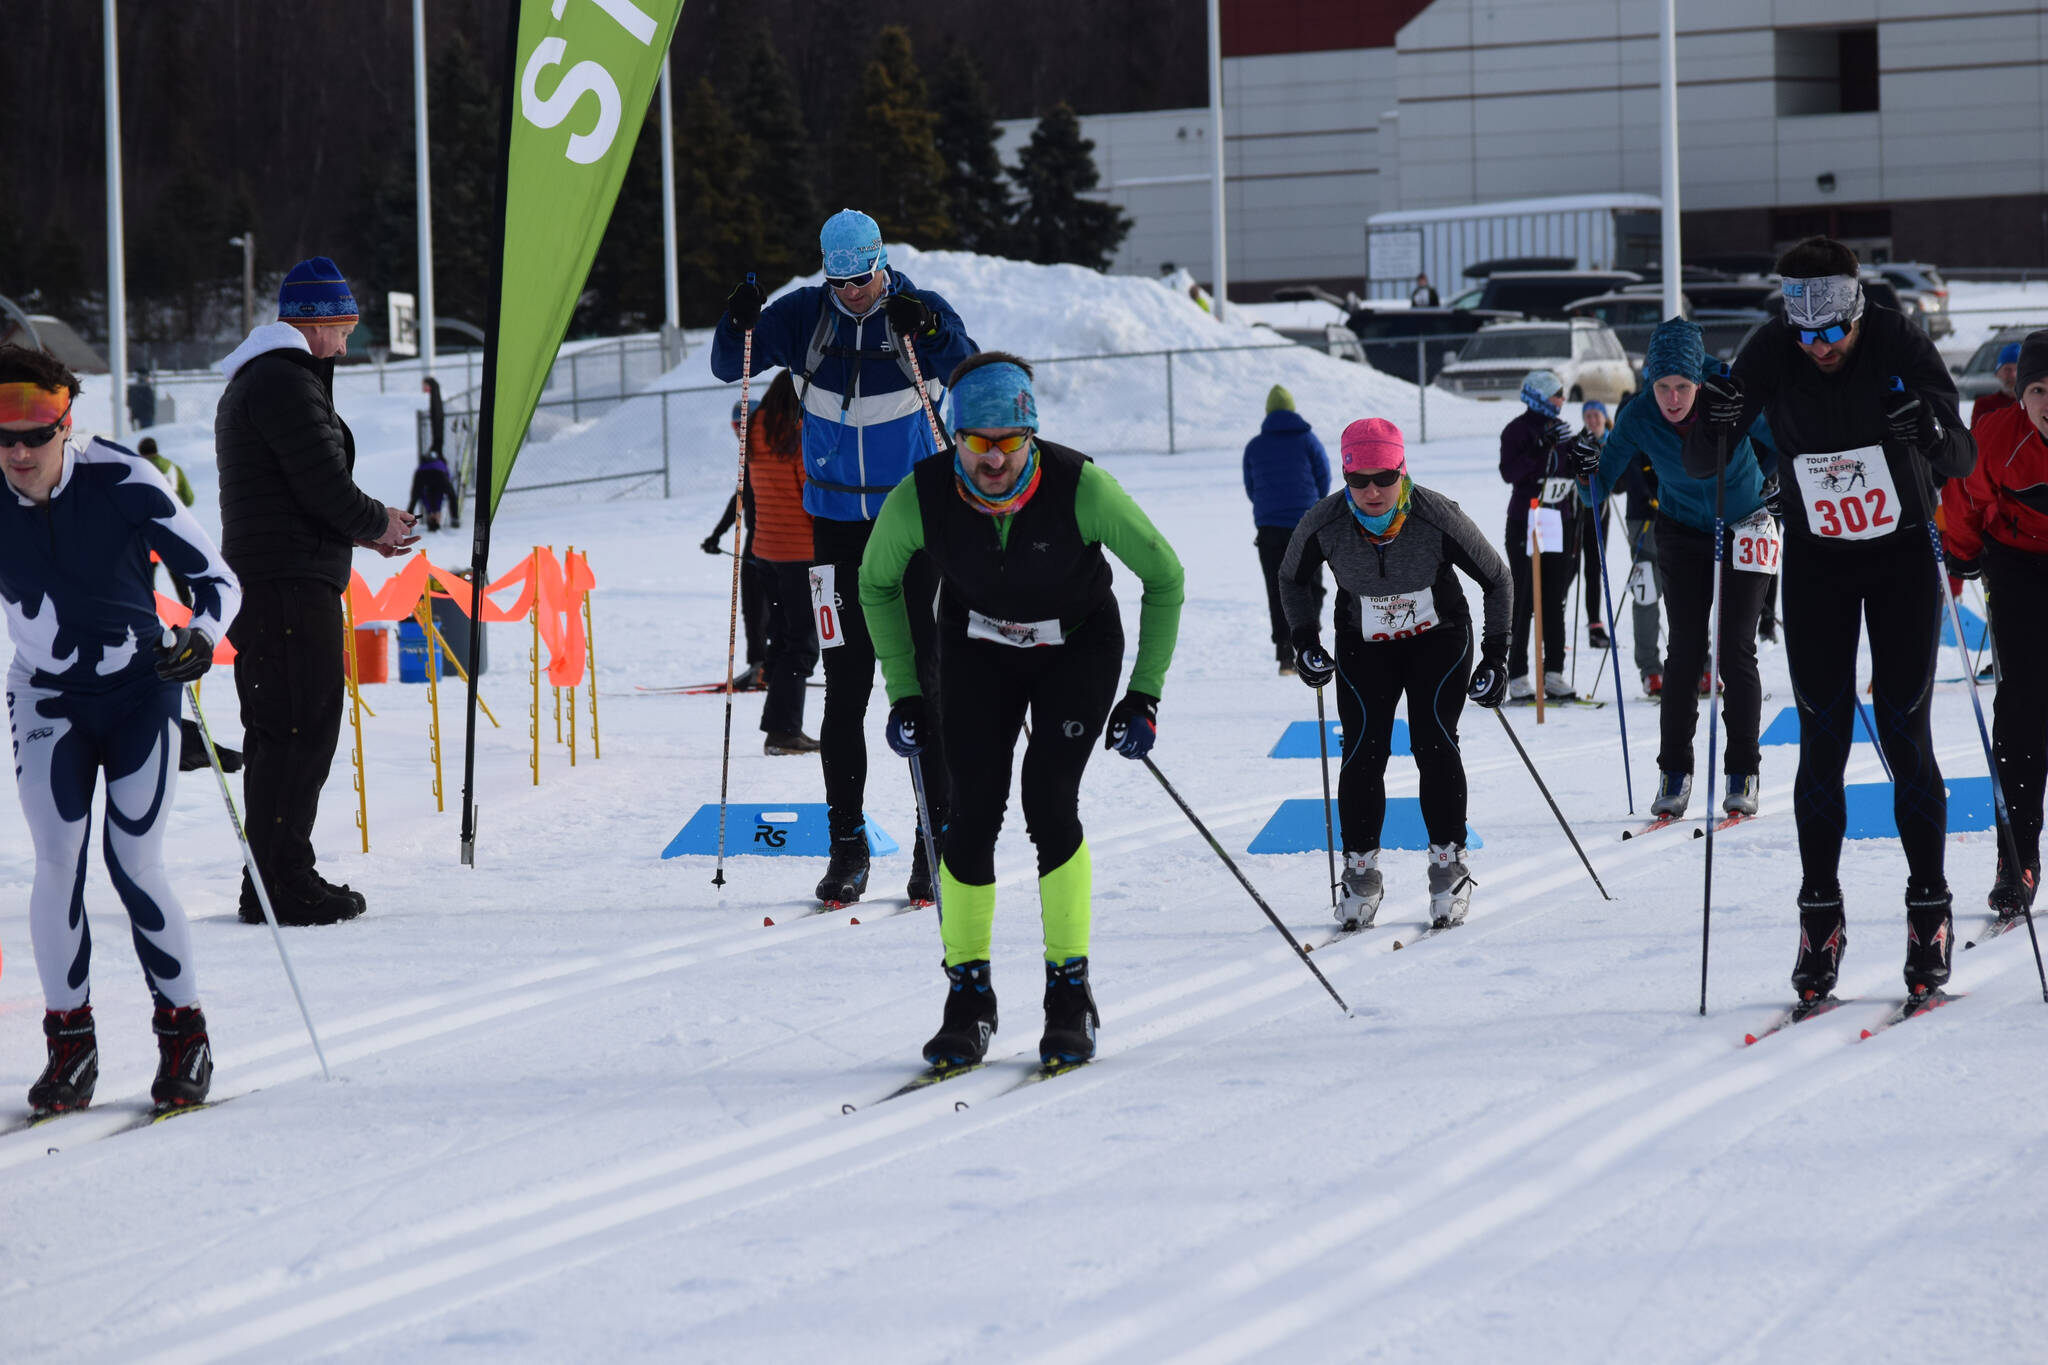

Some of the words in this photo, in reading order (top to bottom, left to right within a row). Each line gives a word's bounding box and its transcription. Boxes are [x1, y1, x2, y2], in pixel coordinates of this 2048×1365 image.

[1806, 456, 1829, 464] TOUR
[1814, 488, 1894, 536] 302
[1739, 537, 1780, 568] 307
[753, 825, 788, 848] RS
